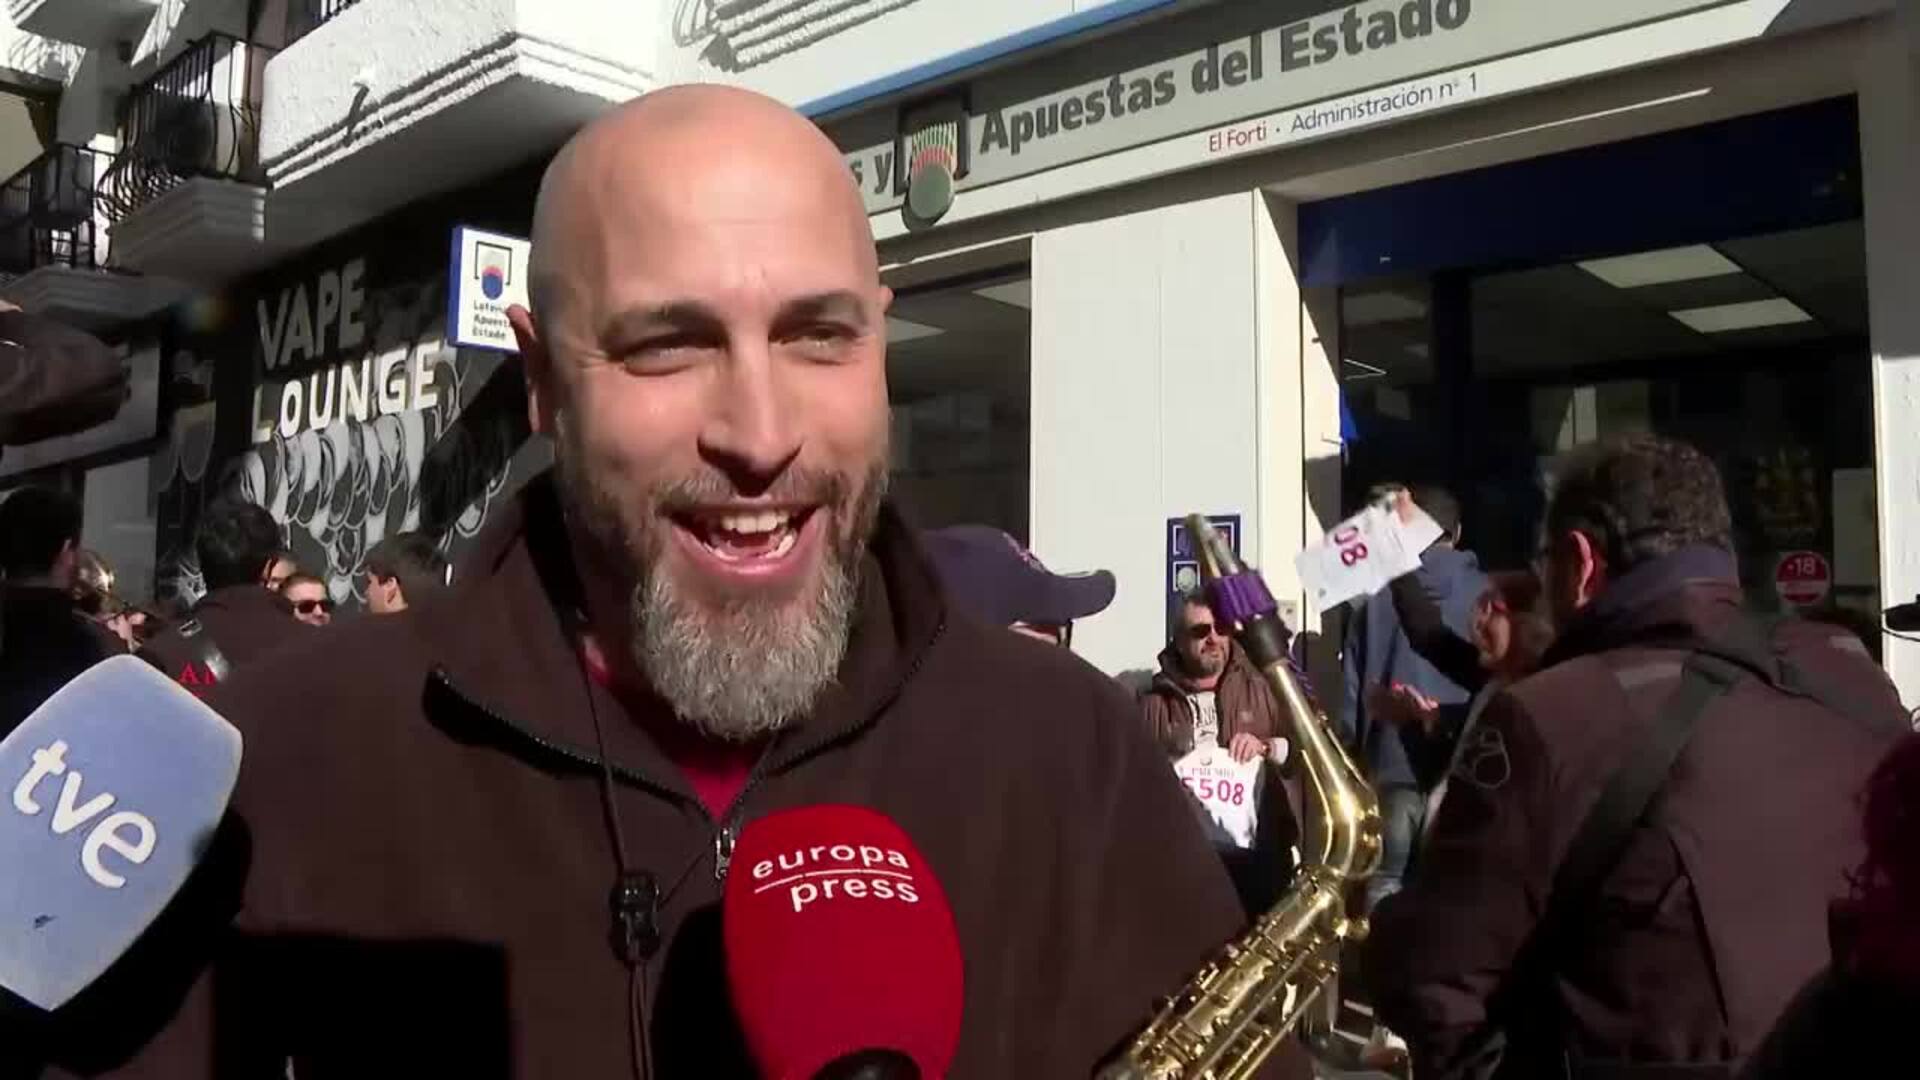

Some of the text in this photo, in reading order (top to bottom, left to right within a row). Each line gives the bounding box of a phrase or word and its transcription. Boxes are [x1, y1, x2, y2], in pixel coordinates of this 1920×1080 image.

[874, 0, 1472, 194] y Apuestas del Estado
[1208, 135, 1222, 153] El
[1227, 121, 1267, 148] Forti
[1290, 86, 1433, 134] Administración
[1468, 71, 1478, 93] 1
[257, 257, 366, 371] VAPE
[252, 338, 441, 443] LOUNGE
[12, 739, 157, 889] tve
[752, 844, 911, 879] europa
[790, 877, 920, 912] press
